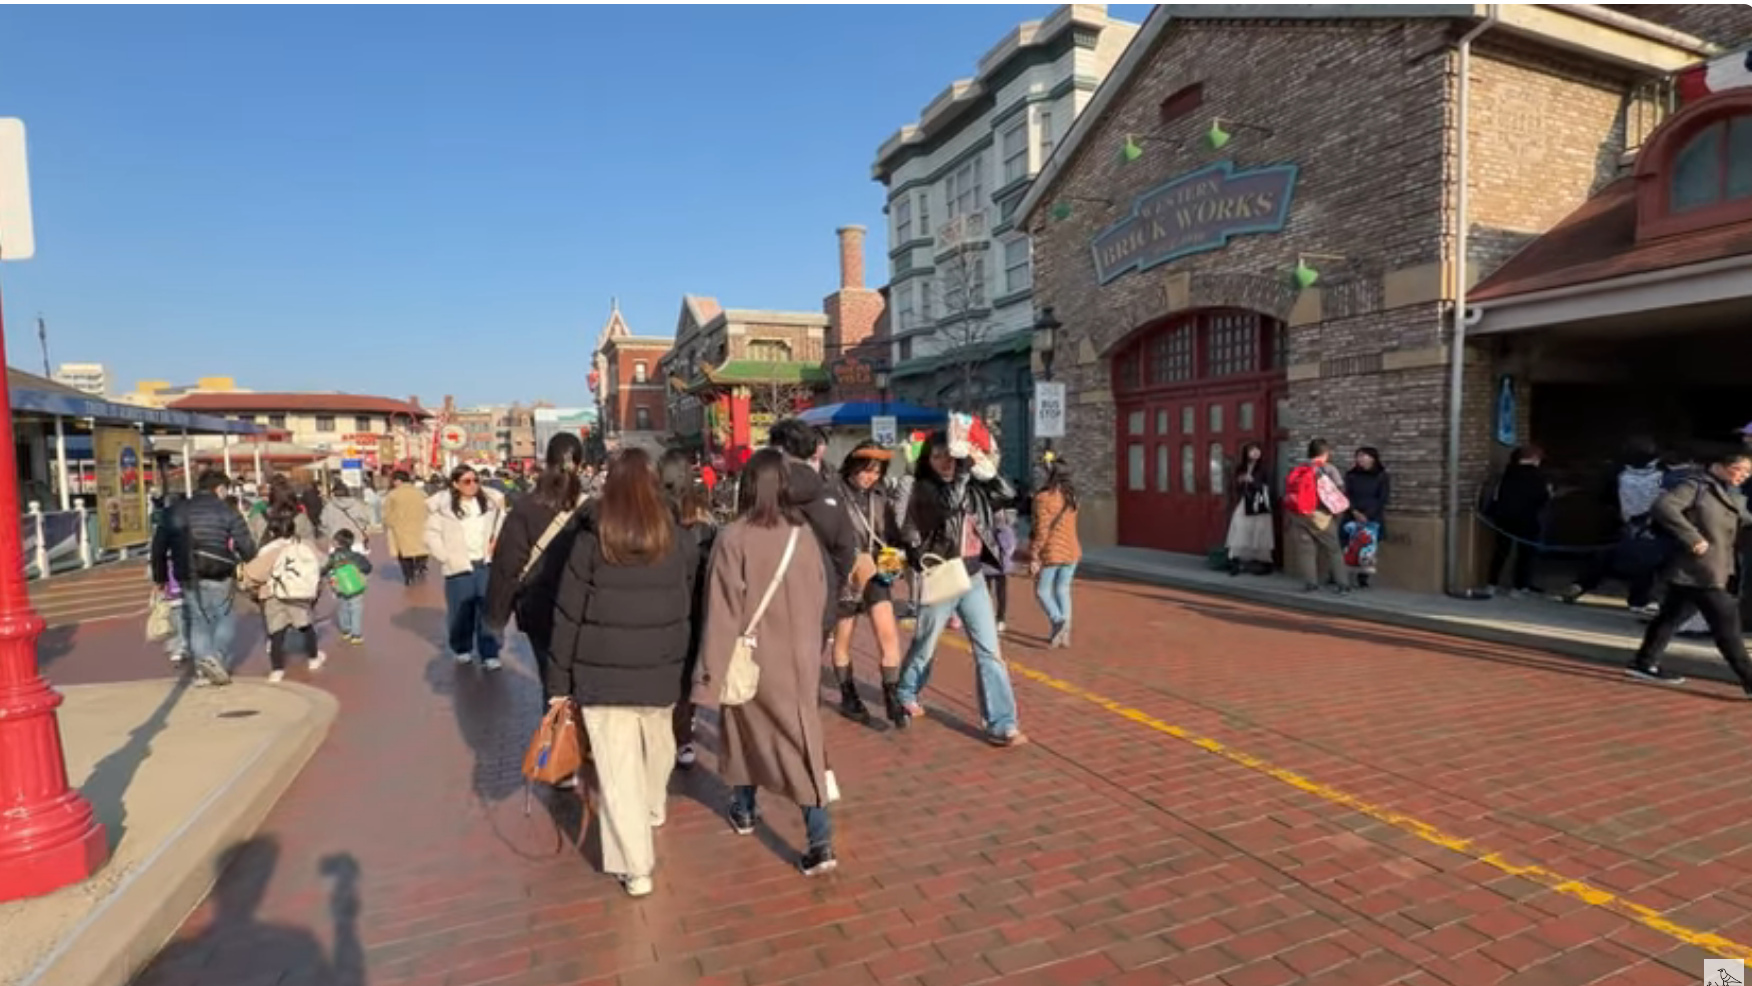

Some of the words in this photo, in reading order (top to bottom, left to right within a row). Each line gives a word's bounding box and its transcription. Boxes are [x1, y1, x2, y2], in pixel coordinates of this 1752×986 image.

[1141, 181, 1219, 217] WESTERN
[1102, 223, 1167, 268] BRICK
[1176, 192, 1272, 229] WORKS
[1039, 408, 1061, 419] STOP
[1042, 400, 1059, 409] BUS
